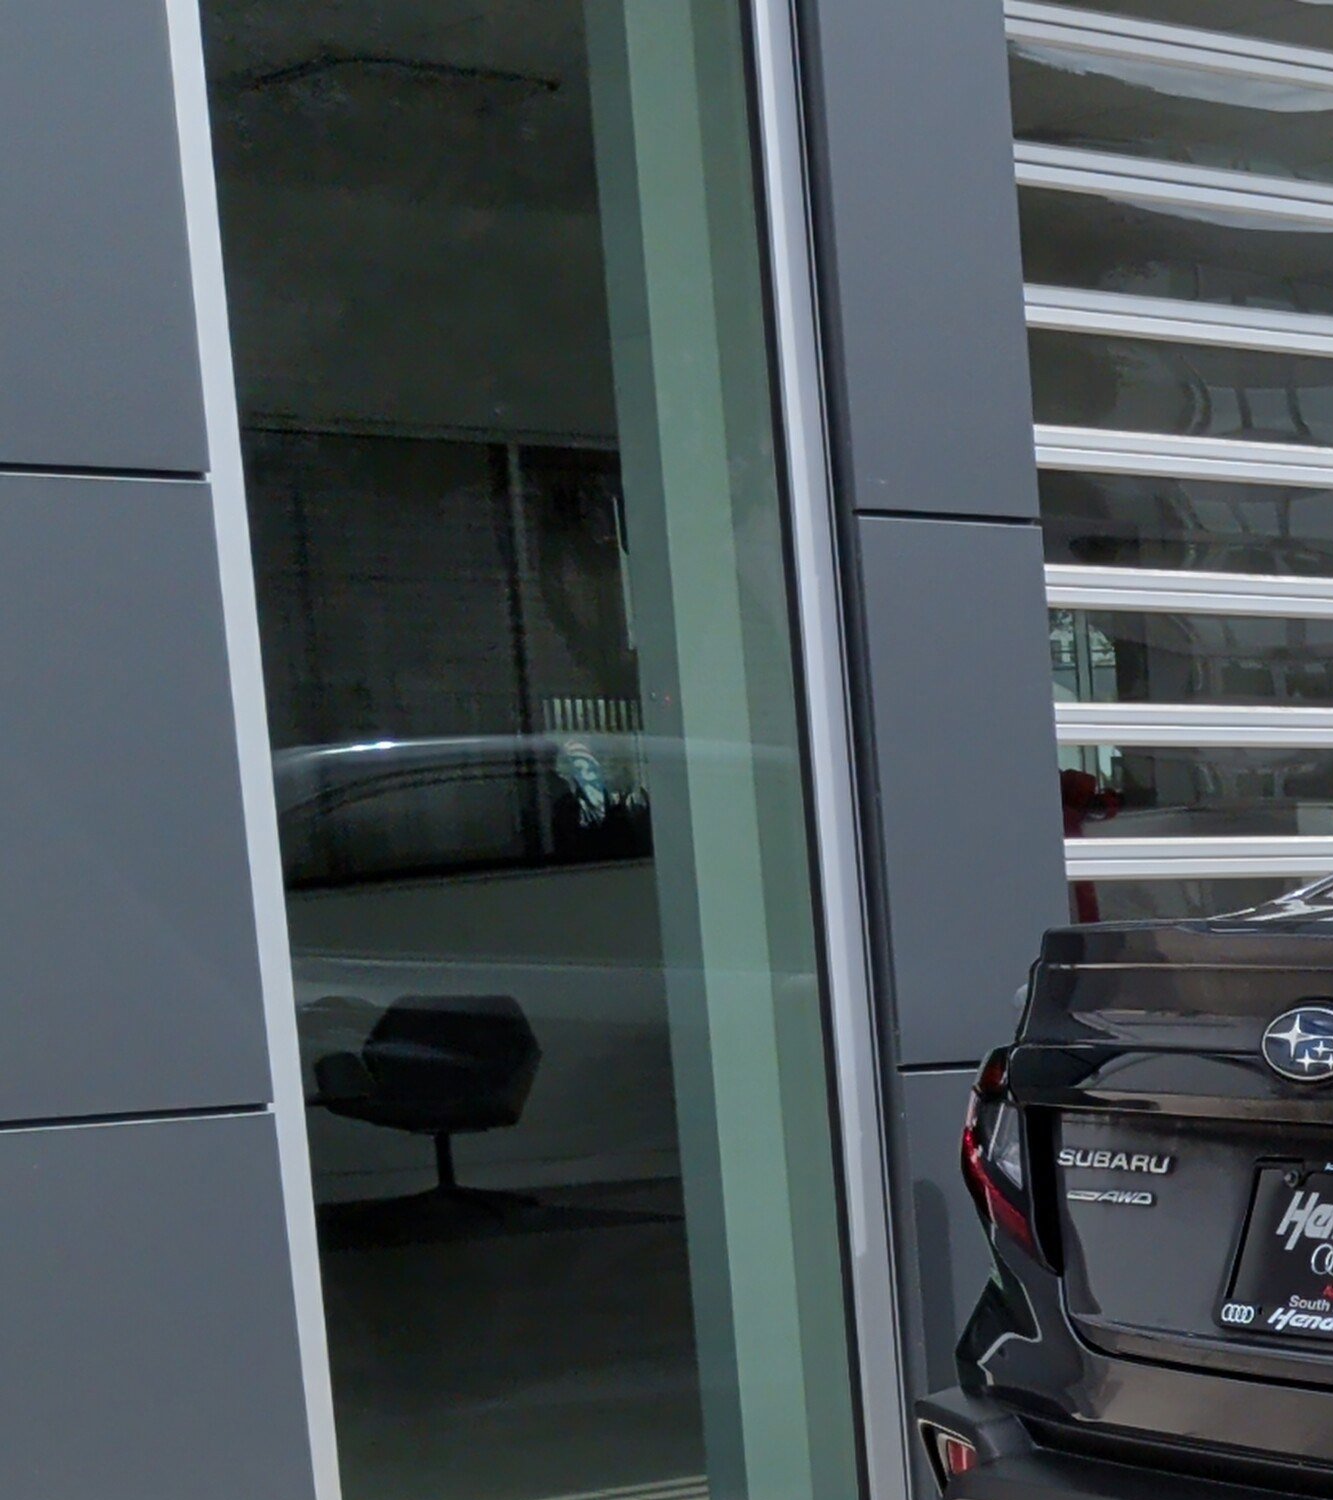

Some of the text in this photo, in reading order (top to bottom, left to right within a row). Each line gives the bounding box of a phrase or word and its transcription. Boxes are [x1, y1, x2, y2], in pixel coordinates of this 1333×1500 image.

[1057, 1148, 1170, 1174] SUBARU
[1097, 1191, 1152, 1205] AWD
[1289, 1295, 1330, 1312] South
